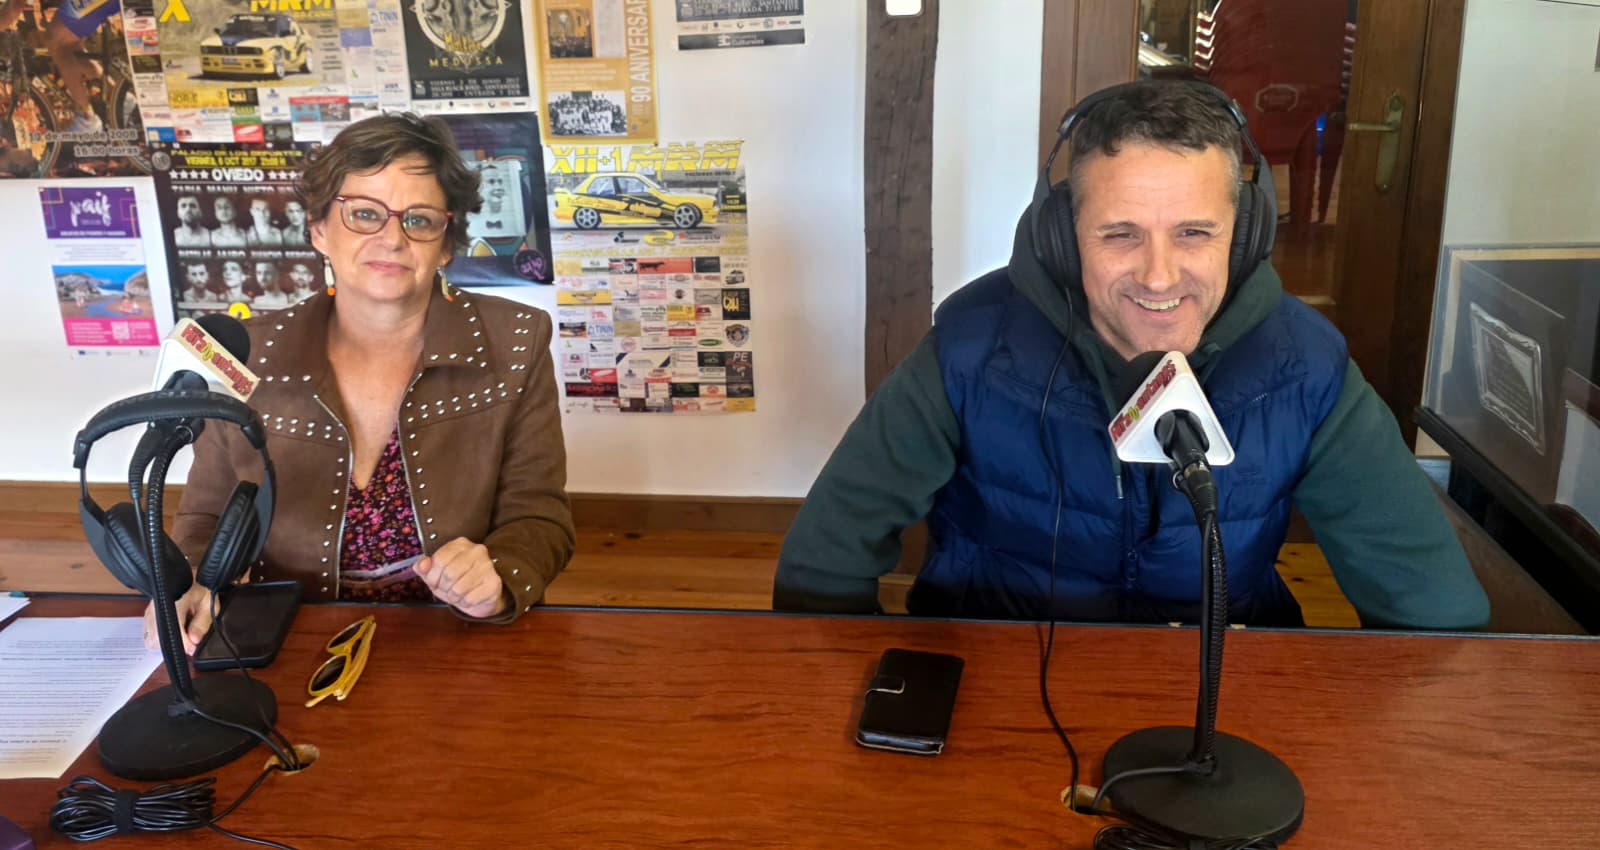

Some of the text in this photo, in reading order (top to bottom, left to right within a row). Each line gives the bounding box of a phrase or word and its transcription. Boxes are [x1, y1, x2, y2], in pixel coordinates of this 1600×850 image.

[627, 0, 651, 103] 90 ANIVERSA
[212, 168, 265, 182] OVIEDO
